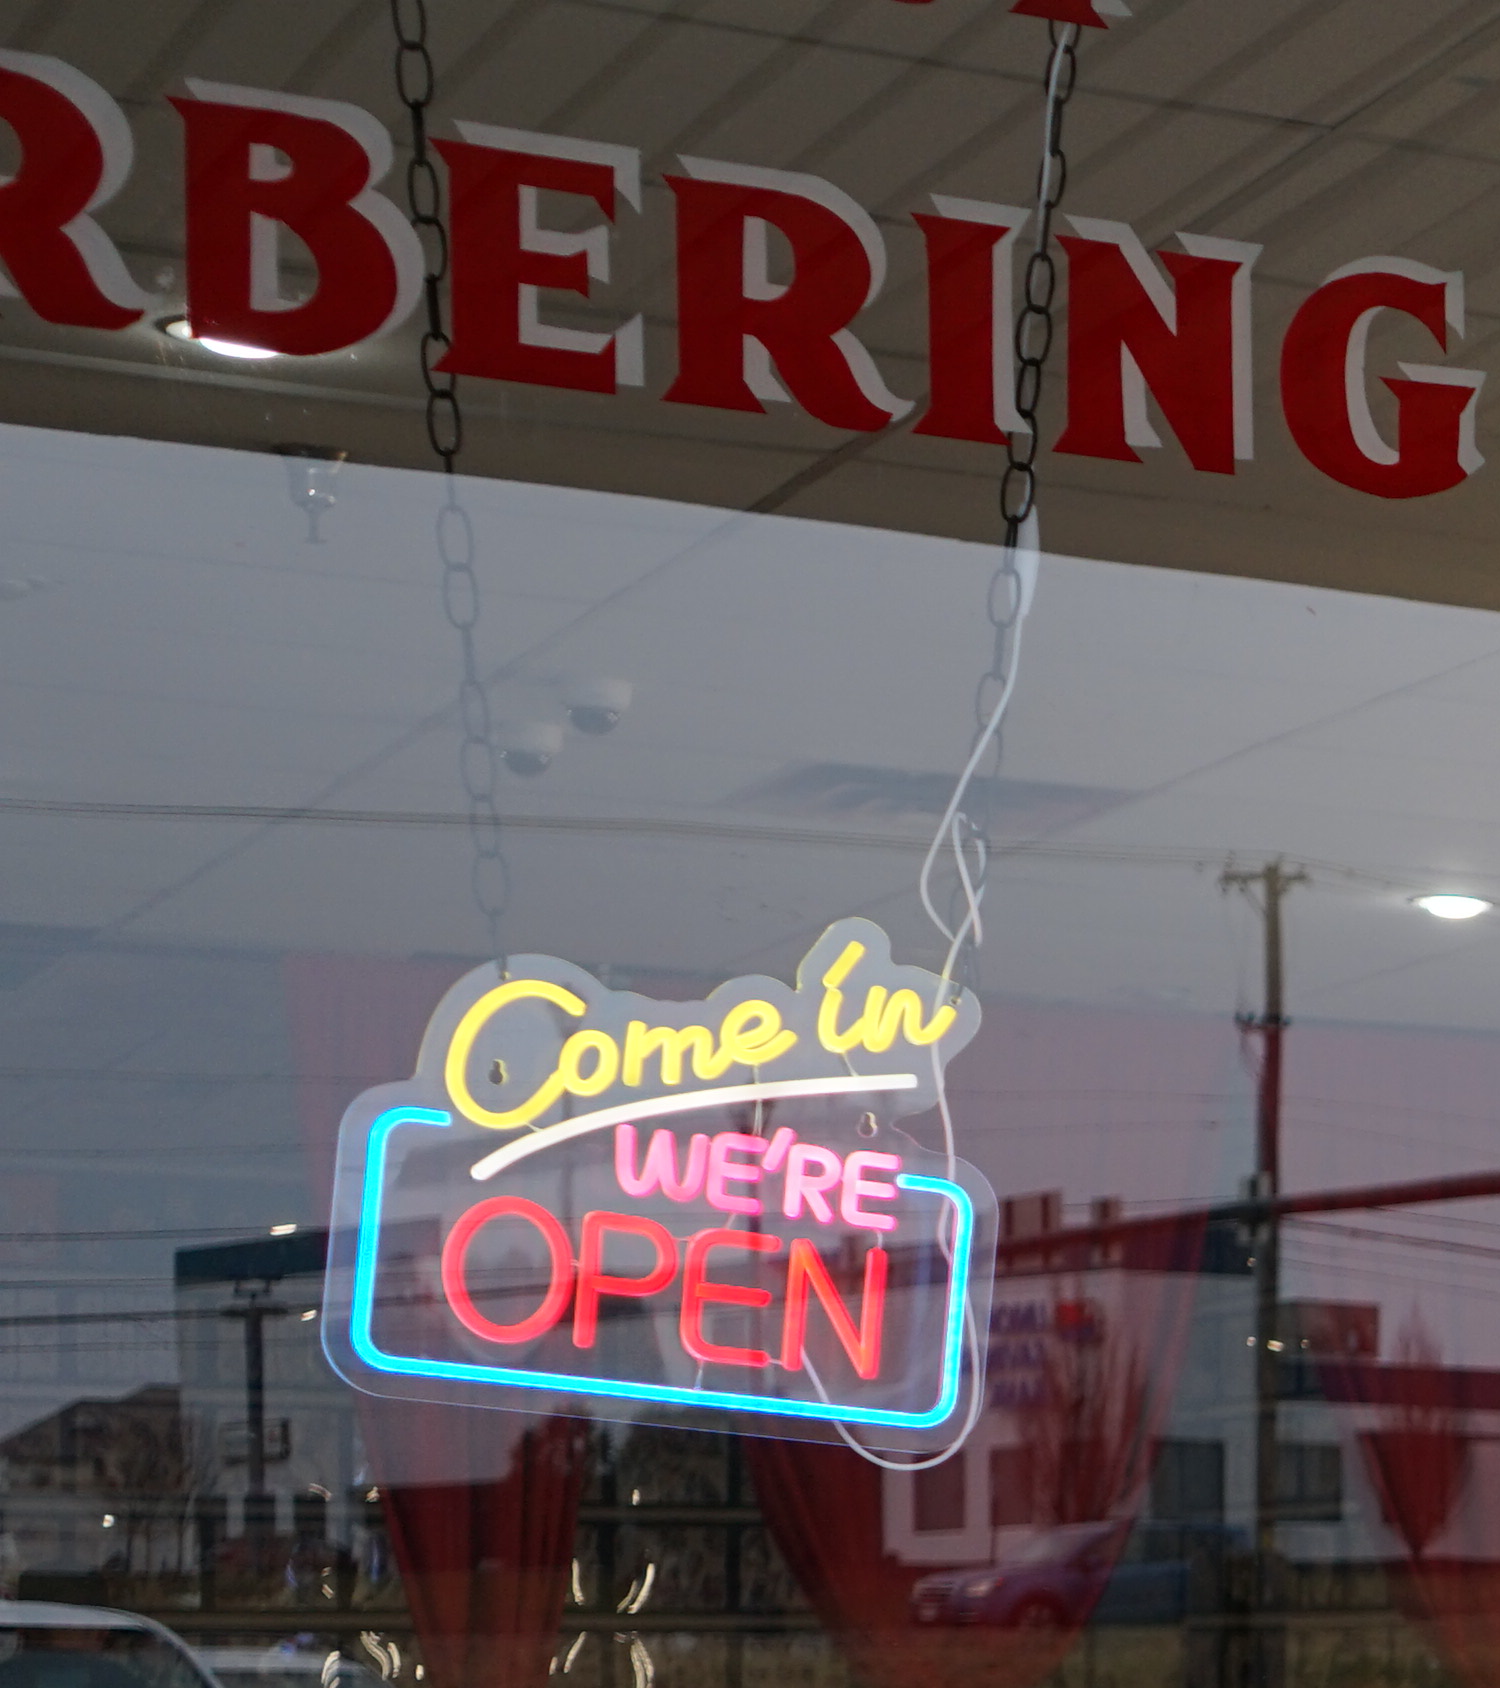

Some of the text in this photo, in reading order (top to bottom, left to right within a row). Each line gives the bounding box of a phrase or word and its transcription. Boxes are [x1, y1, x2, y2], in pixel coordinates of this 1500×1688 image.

[445, 979, 797, 1129] Come
[615, 1123, 903, 1231] WE'RE
[441, 1195, 888, 1380] OPEN
